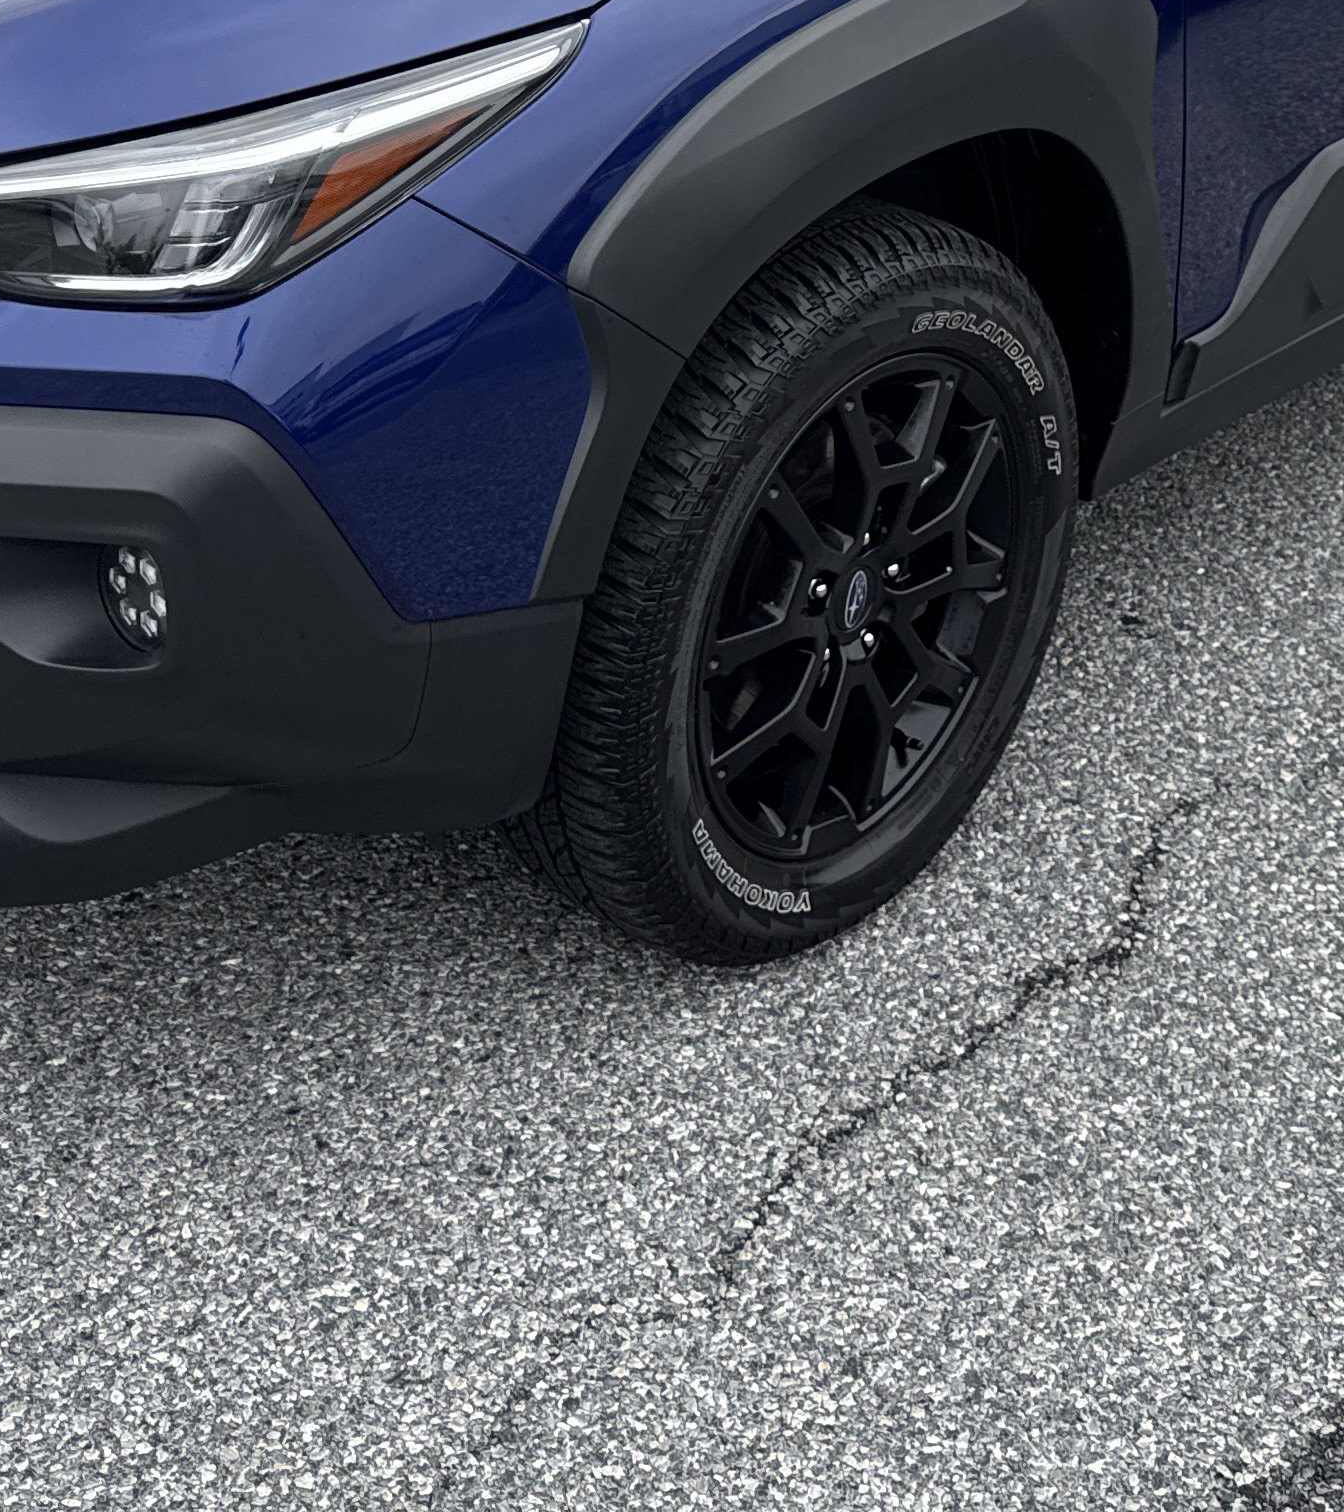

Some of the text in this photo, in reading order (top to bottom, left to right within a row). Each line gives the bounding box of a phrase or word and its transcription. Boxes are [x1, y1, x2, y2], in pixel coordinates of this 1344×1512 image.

[912, 310, 1044, 396] GEOLANDAR
[1040, 415, 1062, 475] A/T
[692, 818, 812, 914] YOKOHAMA
